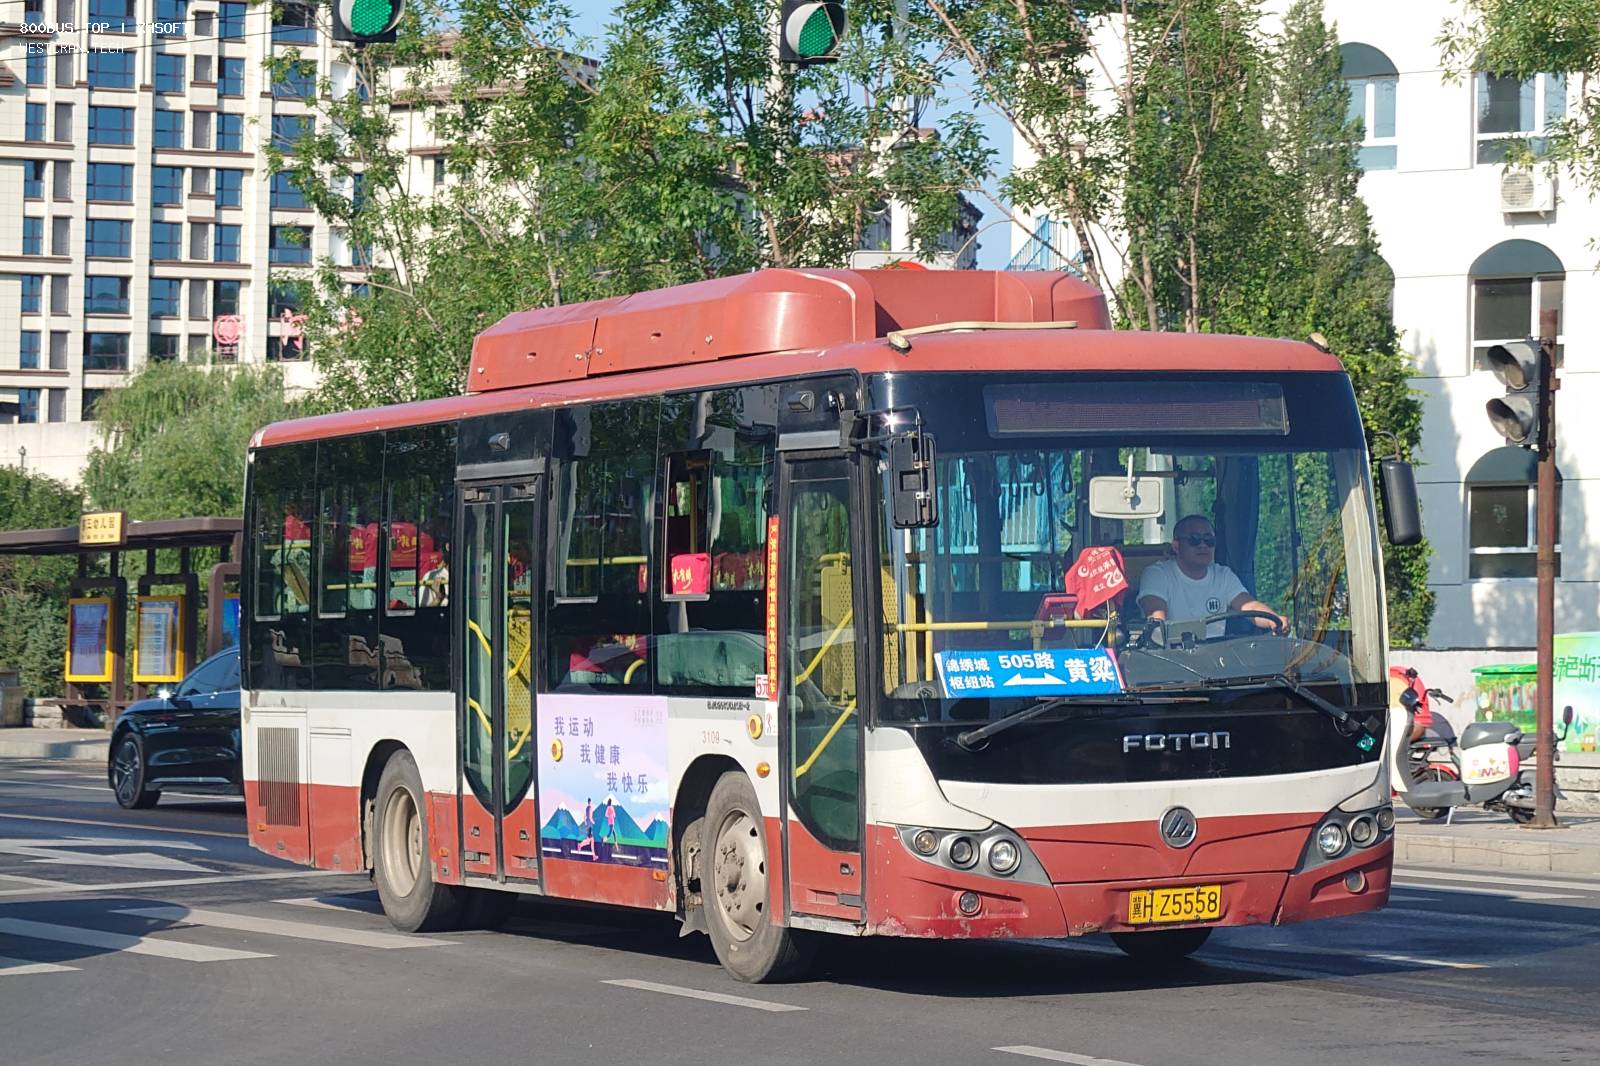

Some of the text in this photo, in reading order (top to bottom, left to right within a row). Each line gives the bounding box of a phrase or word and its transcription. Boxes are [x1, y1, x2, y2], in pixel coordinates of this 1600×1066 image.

[945, 657, 991, 673] 锦绣城
[998, 651, 1056, 670] 505路
[948, 674, 995, 691] 枢纽站
[554, 716, 594, 737] 我运动
[1122, 731, 1231, 753] FOTON
[580, 743, 621, 765] 我健康
[606, 771, 648, 794] 我快乐
[1159, 891, 1218, 917] Z5558
